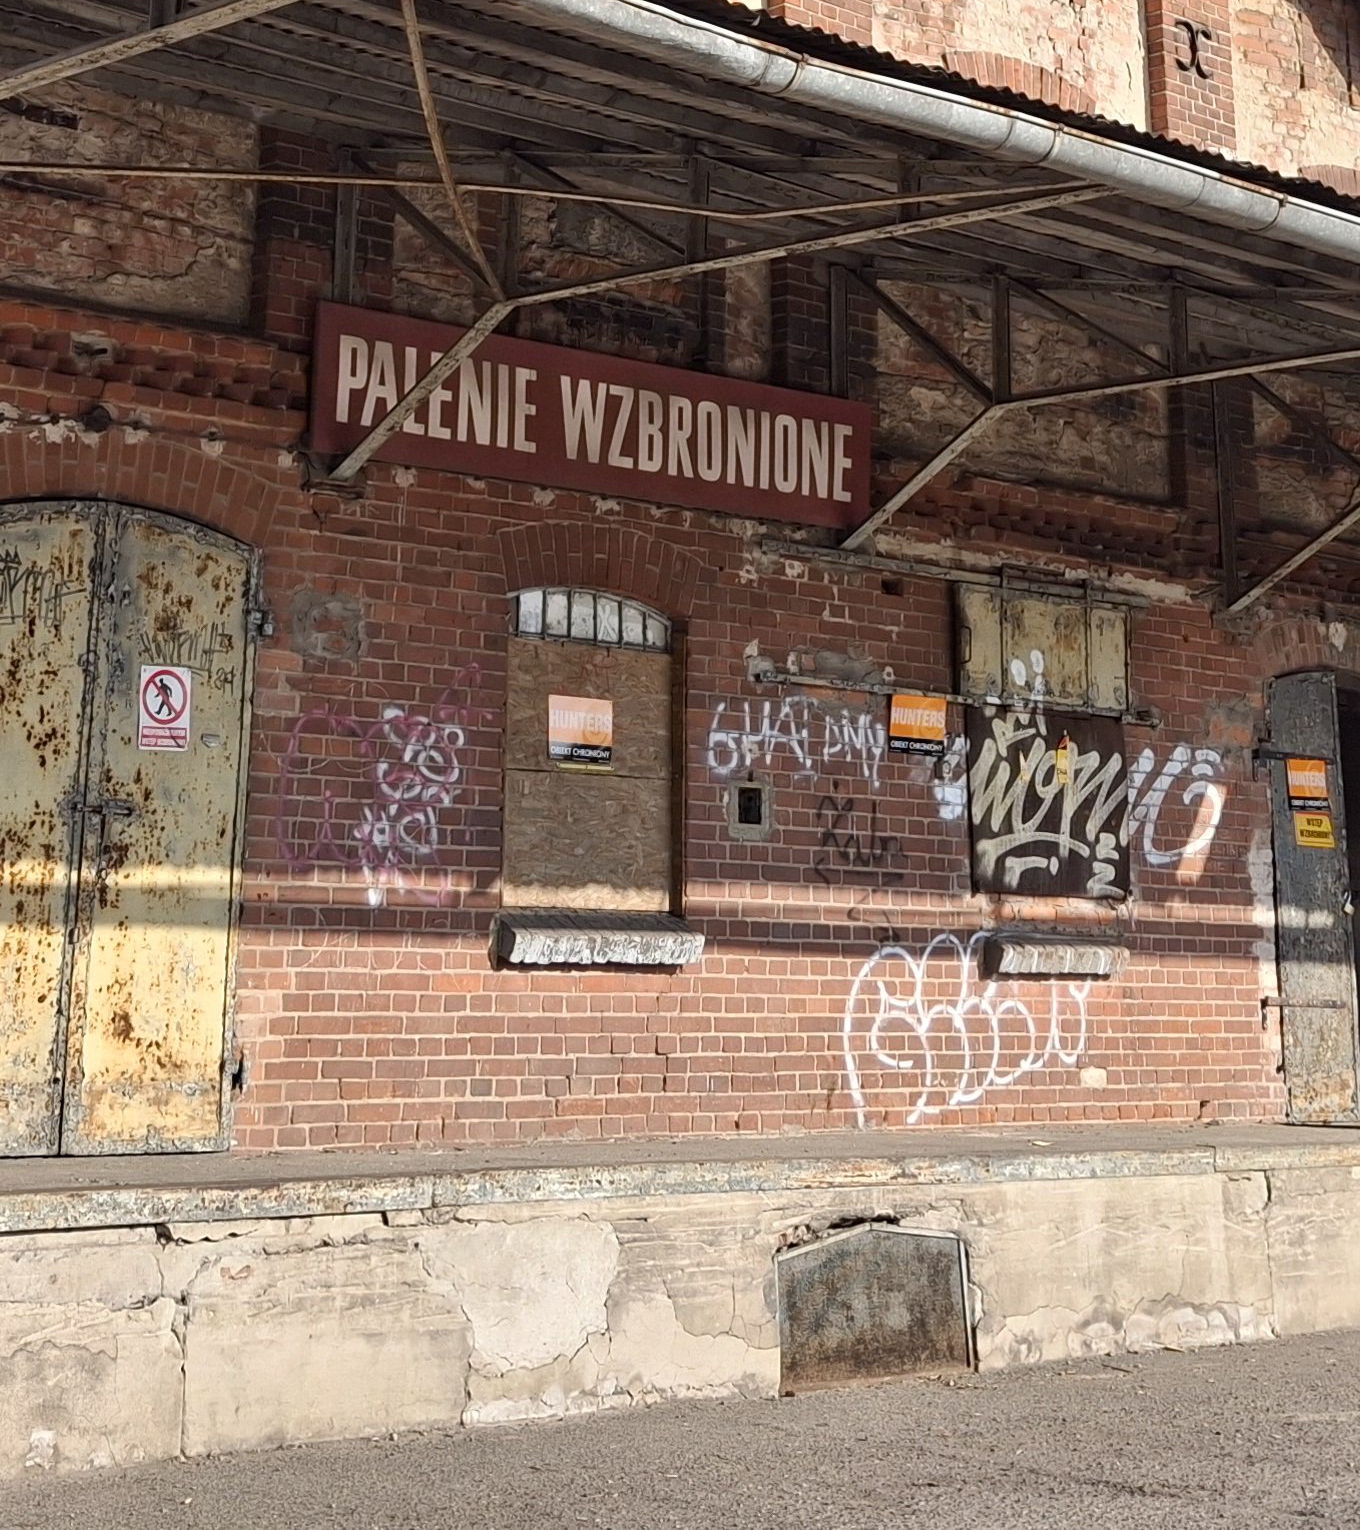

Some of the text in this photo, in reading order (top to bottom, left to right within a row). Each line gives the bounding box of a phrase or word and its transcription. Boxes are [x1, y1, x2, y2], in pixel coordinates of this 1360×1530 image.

[336, 334, 853, 503] PALENIE WZBRONIONE
[551, 709, 611, 734] HUNTERS
[891, 706, 945, 728] HUNTERS
[550, 745, 571, 756] OBIEKT
